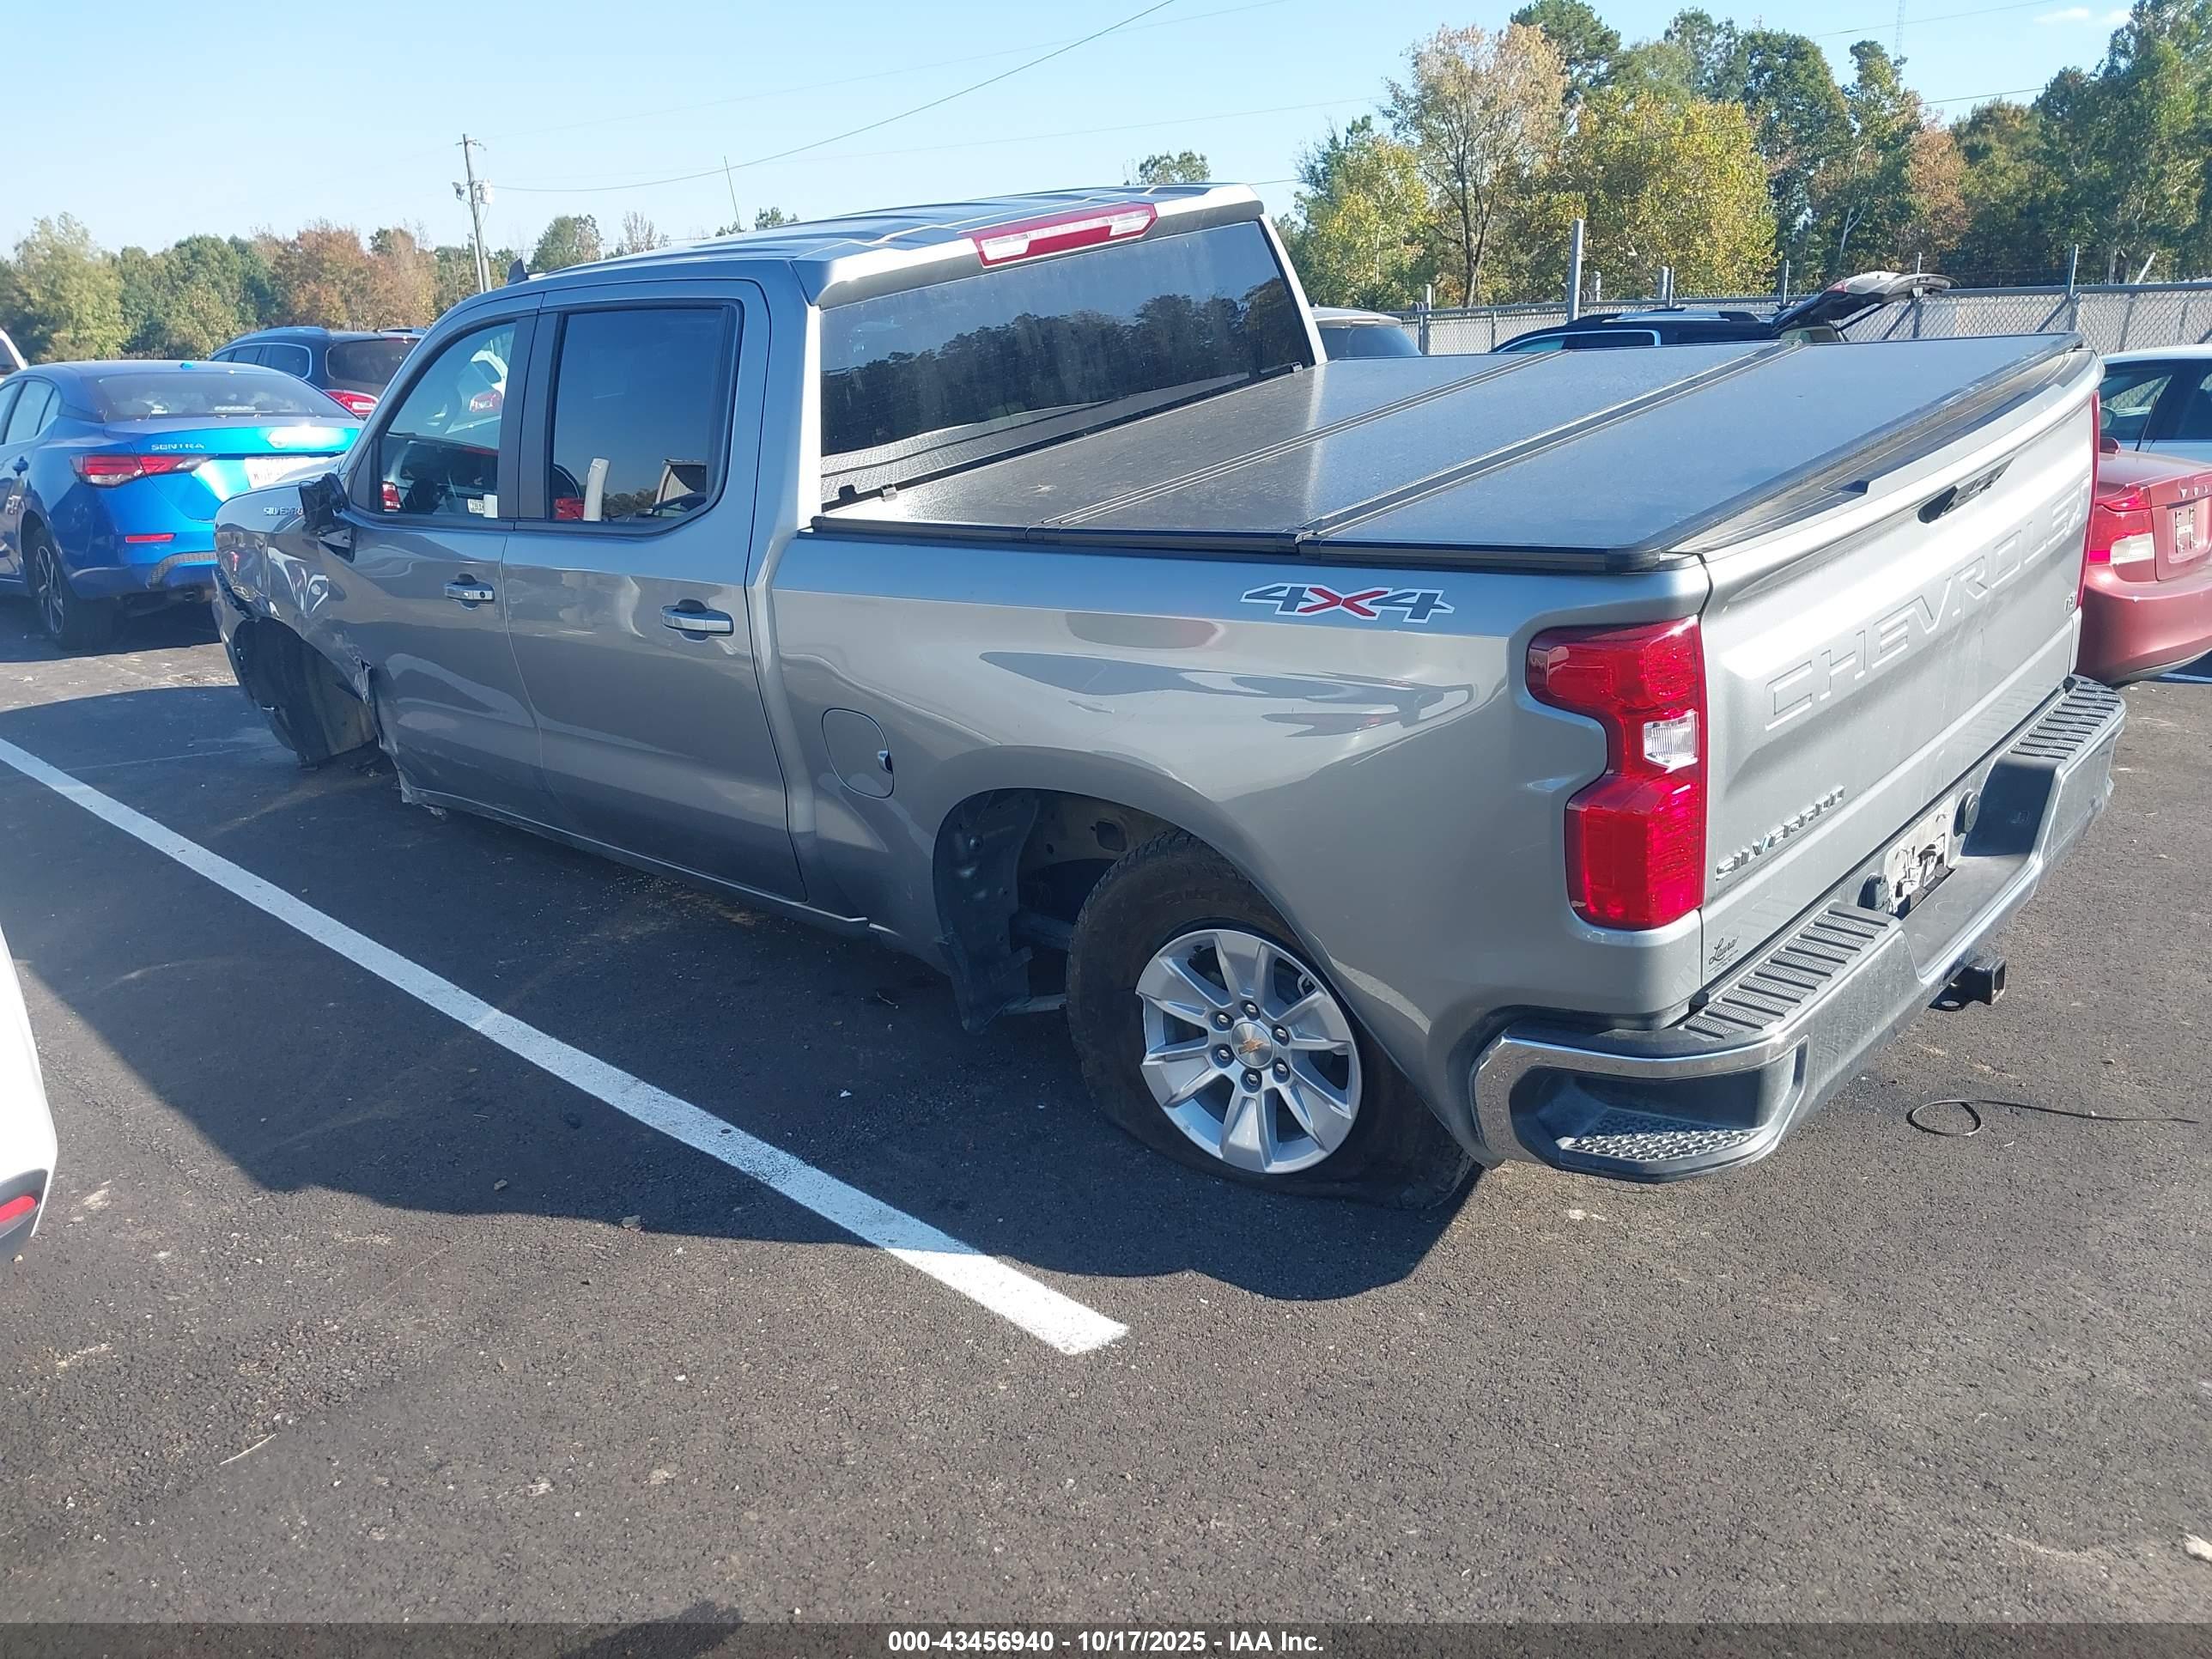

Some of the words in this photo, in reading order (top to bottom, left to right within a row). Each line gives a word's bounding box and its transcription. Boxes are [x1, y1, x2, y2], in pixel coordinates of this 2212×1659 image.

[150, 442, 205, 452] SENTRA
[1764, 475, 2088, 731] CHEVROLET
[1715, 784, 1845, 881] SILVERADO
